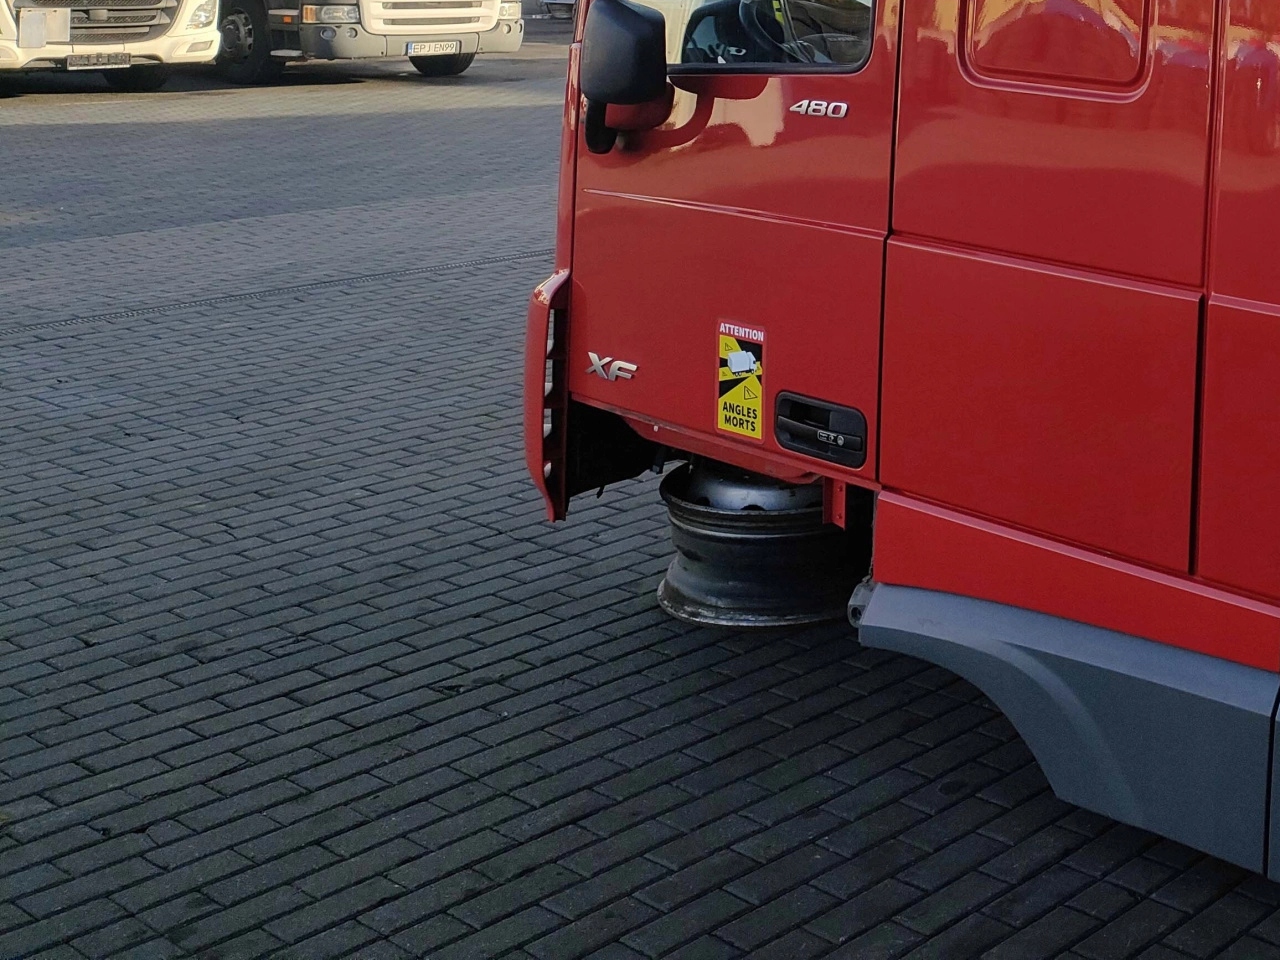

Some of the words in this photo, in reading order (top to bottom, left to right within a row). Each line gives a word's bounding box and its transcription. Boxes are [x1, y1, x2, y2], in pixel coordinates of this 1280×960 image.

[413, 44, 431, 54] EPJ
[433, 42, 455, 53] EN99
[789, 98, 848, 118] 480
[719, 323, 764, 342] ATTENTION
[585, 351, 638, 381] XF
[722, 401, 758, 420] ANGLES
[724, 414, 756, 433] MORTS
